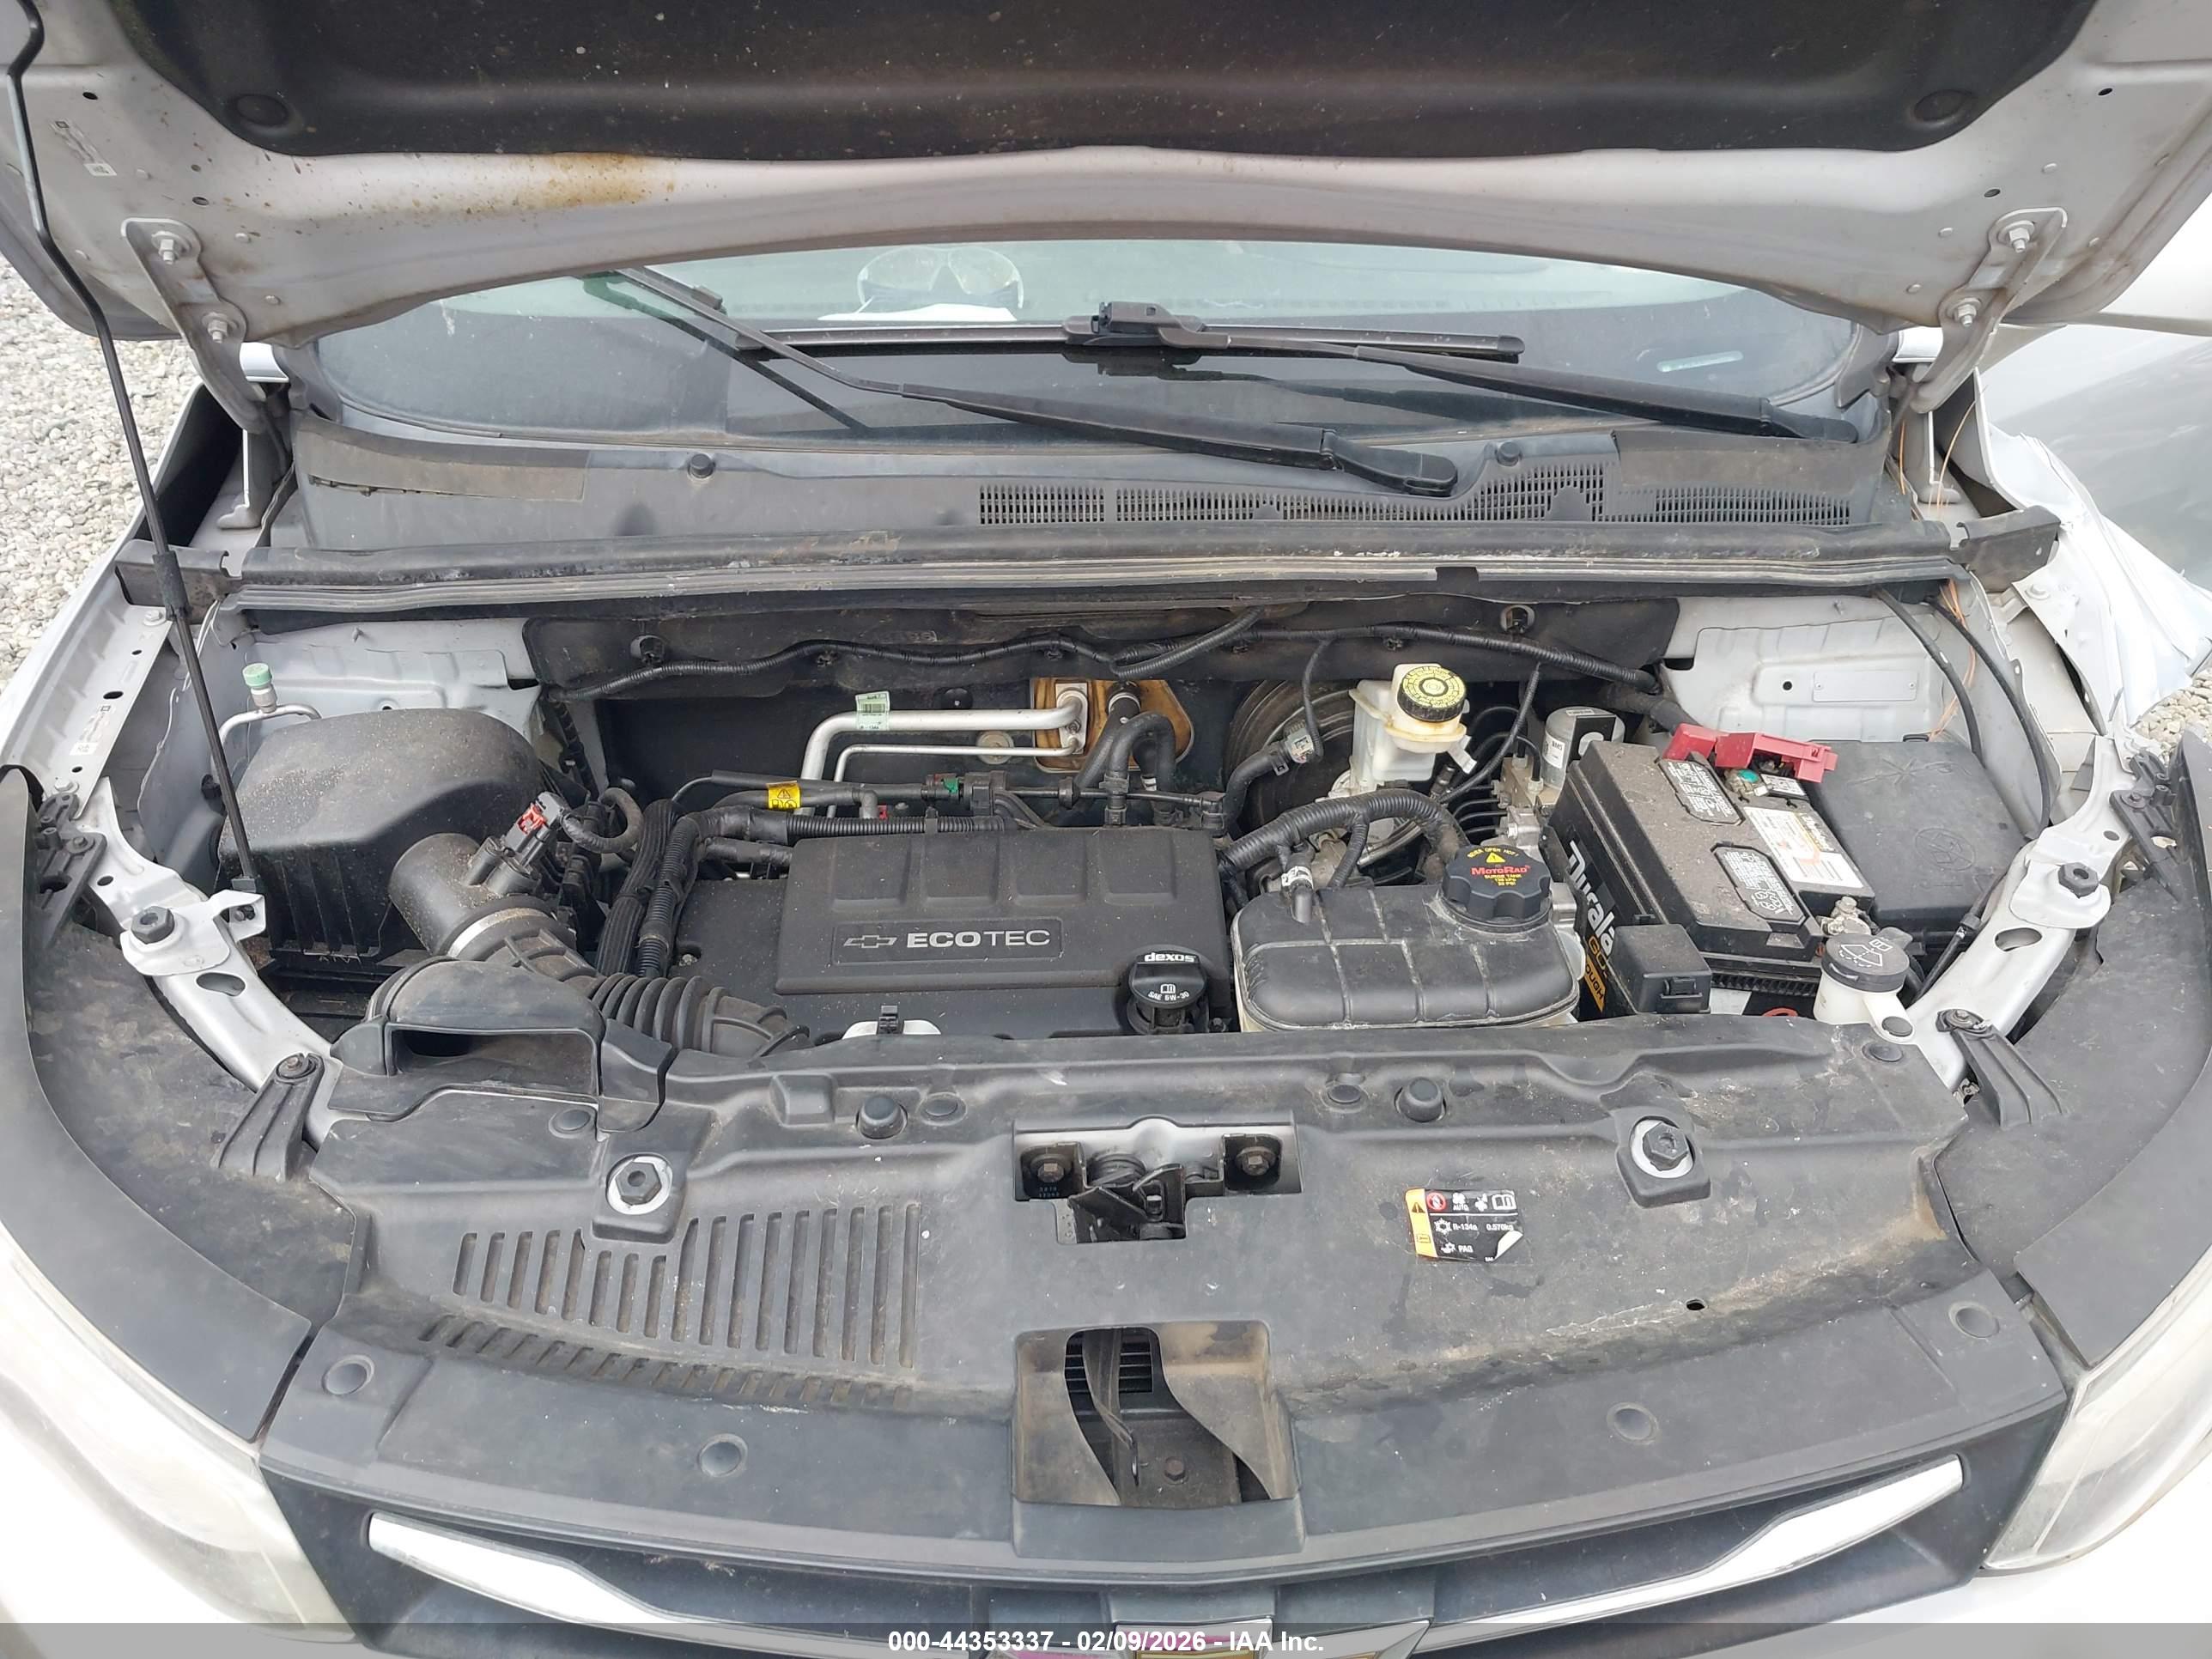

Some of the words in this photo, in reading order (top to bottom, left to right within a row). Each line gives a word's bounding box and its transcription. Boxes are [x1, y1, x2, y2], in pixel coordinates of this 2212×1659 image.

[907, 930, 1050, 948] ECOTEC
[1145, 952, 1196, 963] dexos
[1585, 963, 1606, 1000] OUGH
